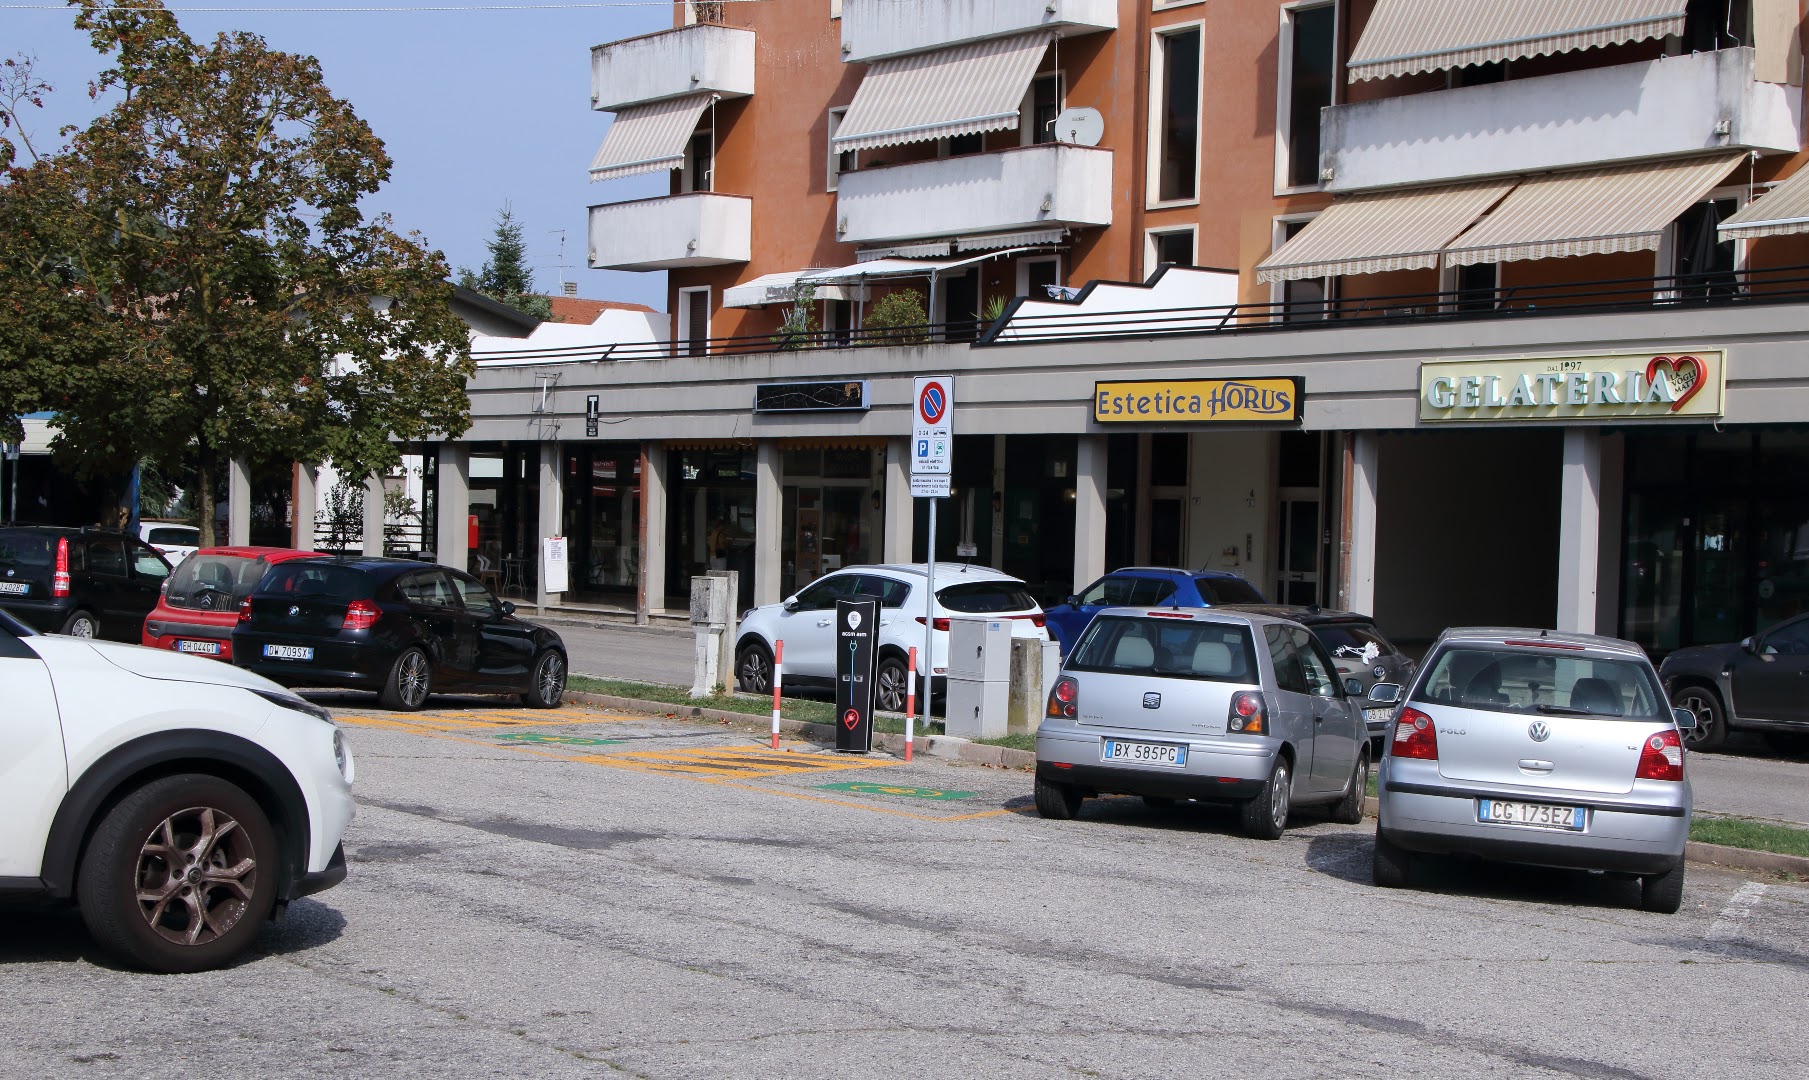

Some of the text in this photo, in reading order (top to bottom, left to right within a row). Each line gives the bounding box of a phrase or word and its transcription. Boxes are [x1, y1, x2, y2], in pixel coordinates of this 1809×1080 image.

[1427, 369, 1677, 408] GELATERIA
[1098, 381, 1292, 419] Estetica HORUS
[182, 641, 215, 653] EH 044GT
[269, 646, 308, 658] DW 709SX
[1114, 743, 1130, 758] BX
[1135, 745, 1176, 762] 585PG
[1493, 802, 1513, 820] CG
[1521, 804, 1572, 825] 173EZ
